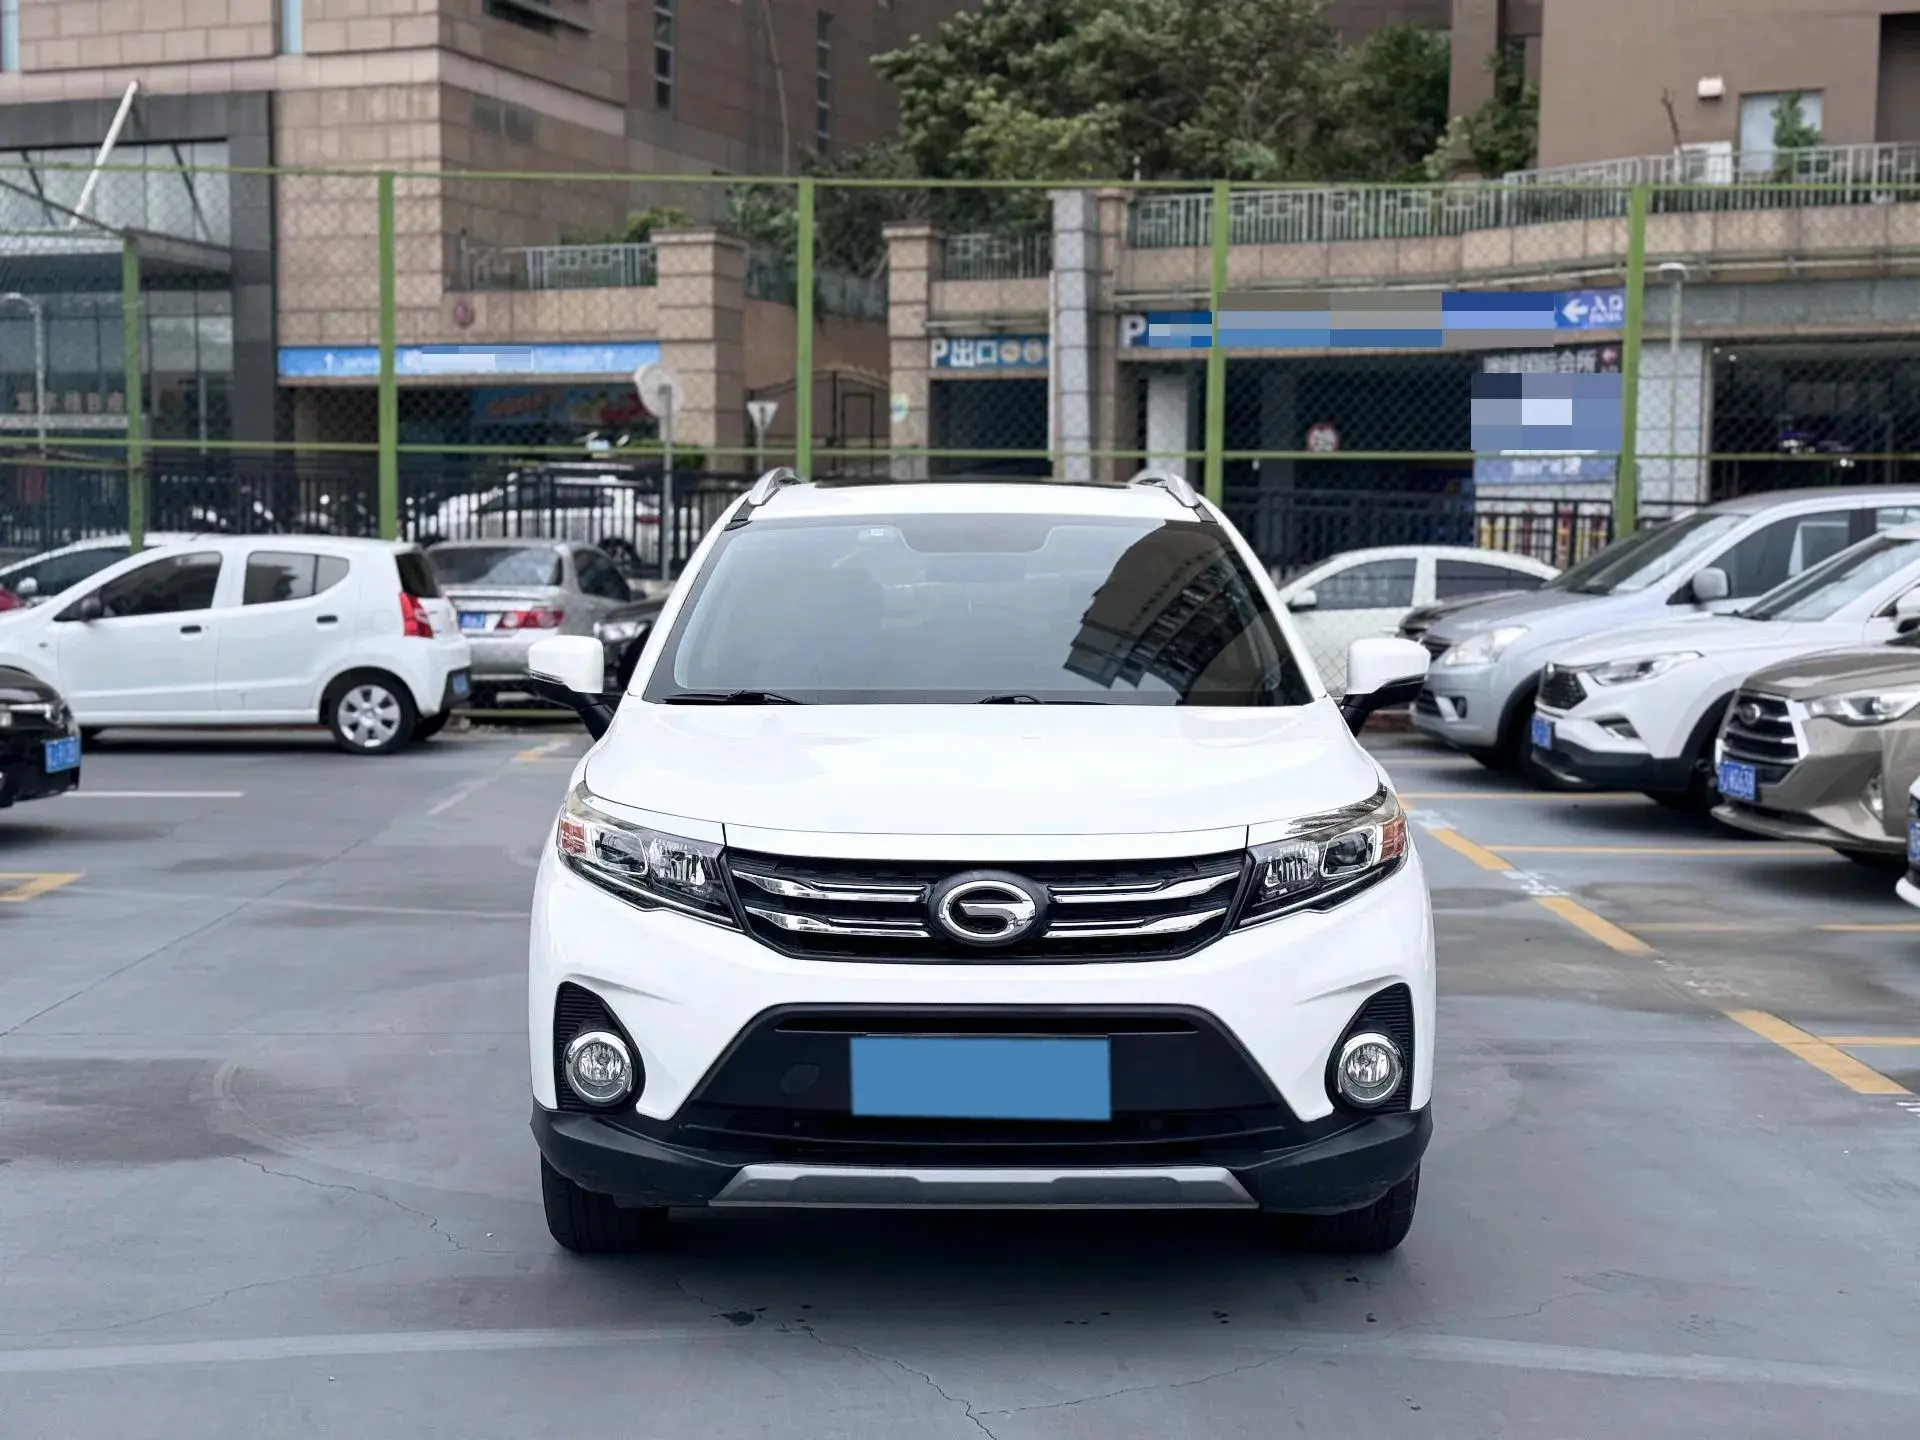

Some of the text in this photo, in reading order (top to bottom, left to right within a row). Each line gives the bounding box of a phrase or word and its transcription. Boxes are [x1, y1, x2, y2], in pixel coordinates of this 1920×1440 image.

[1121, 314, 1148, 348] P
[931, 338, 998, 369] P 出口
